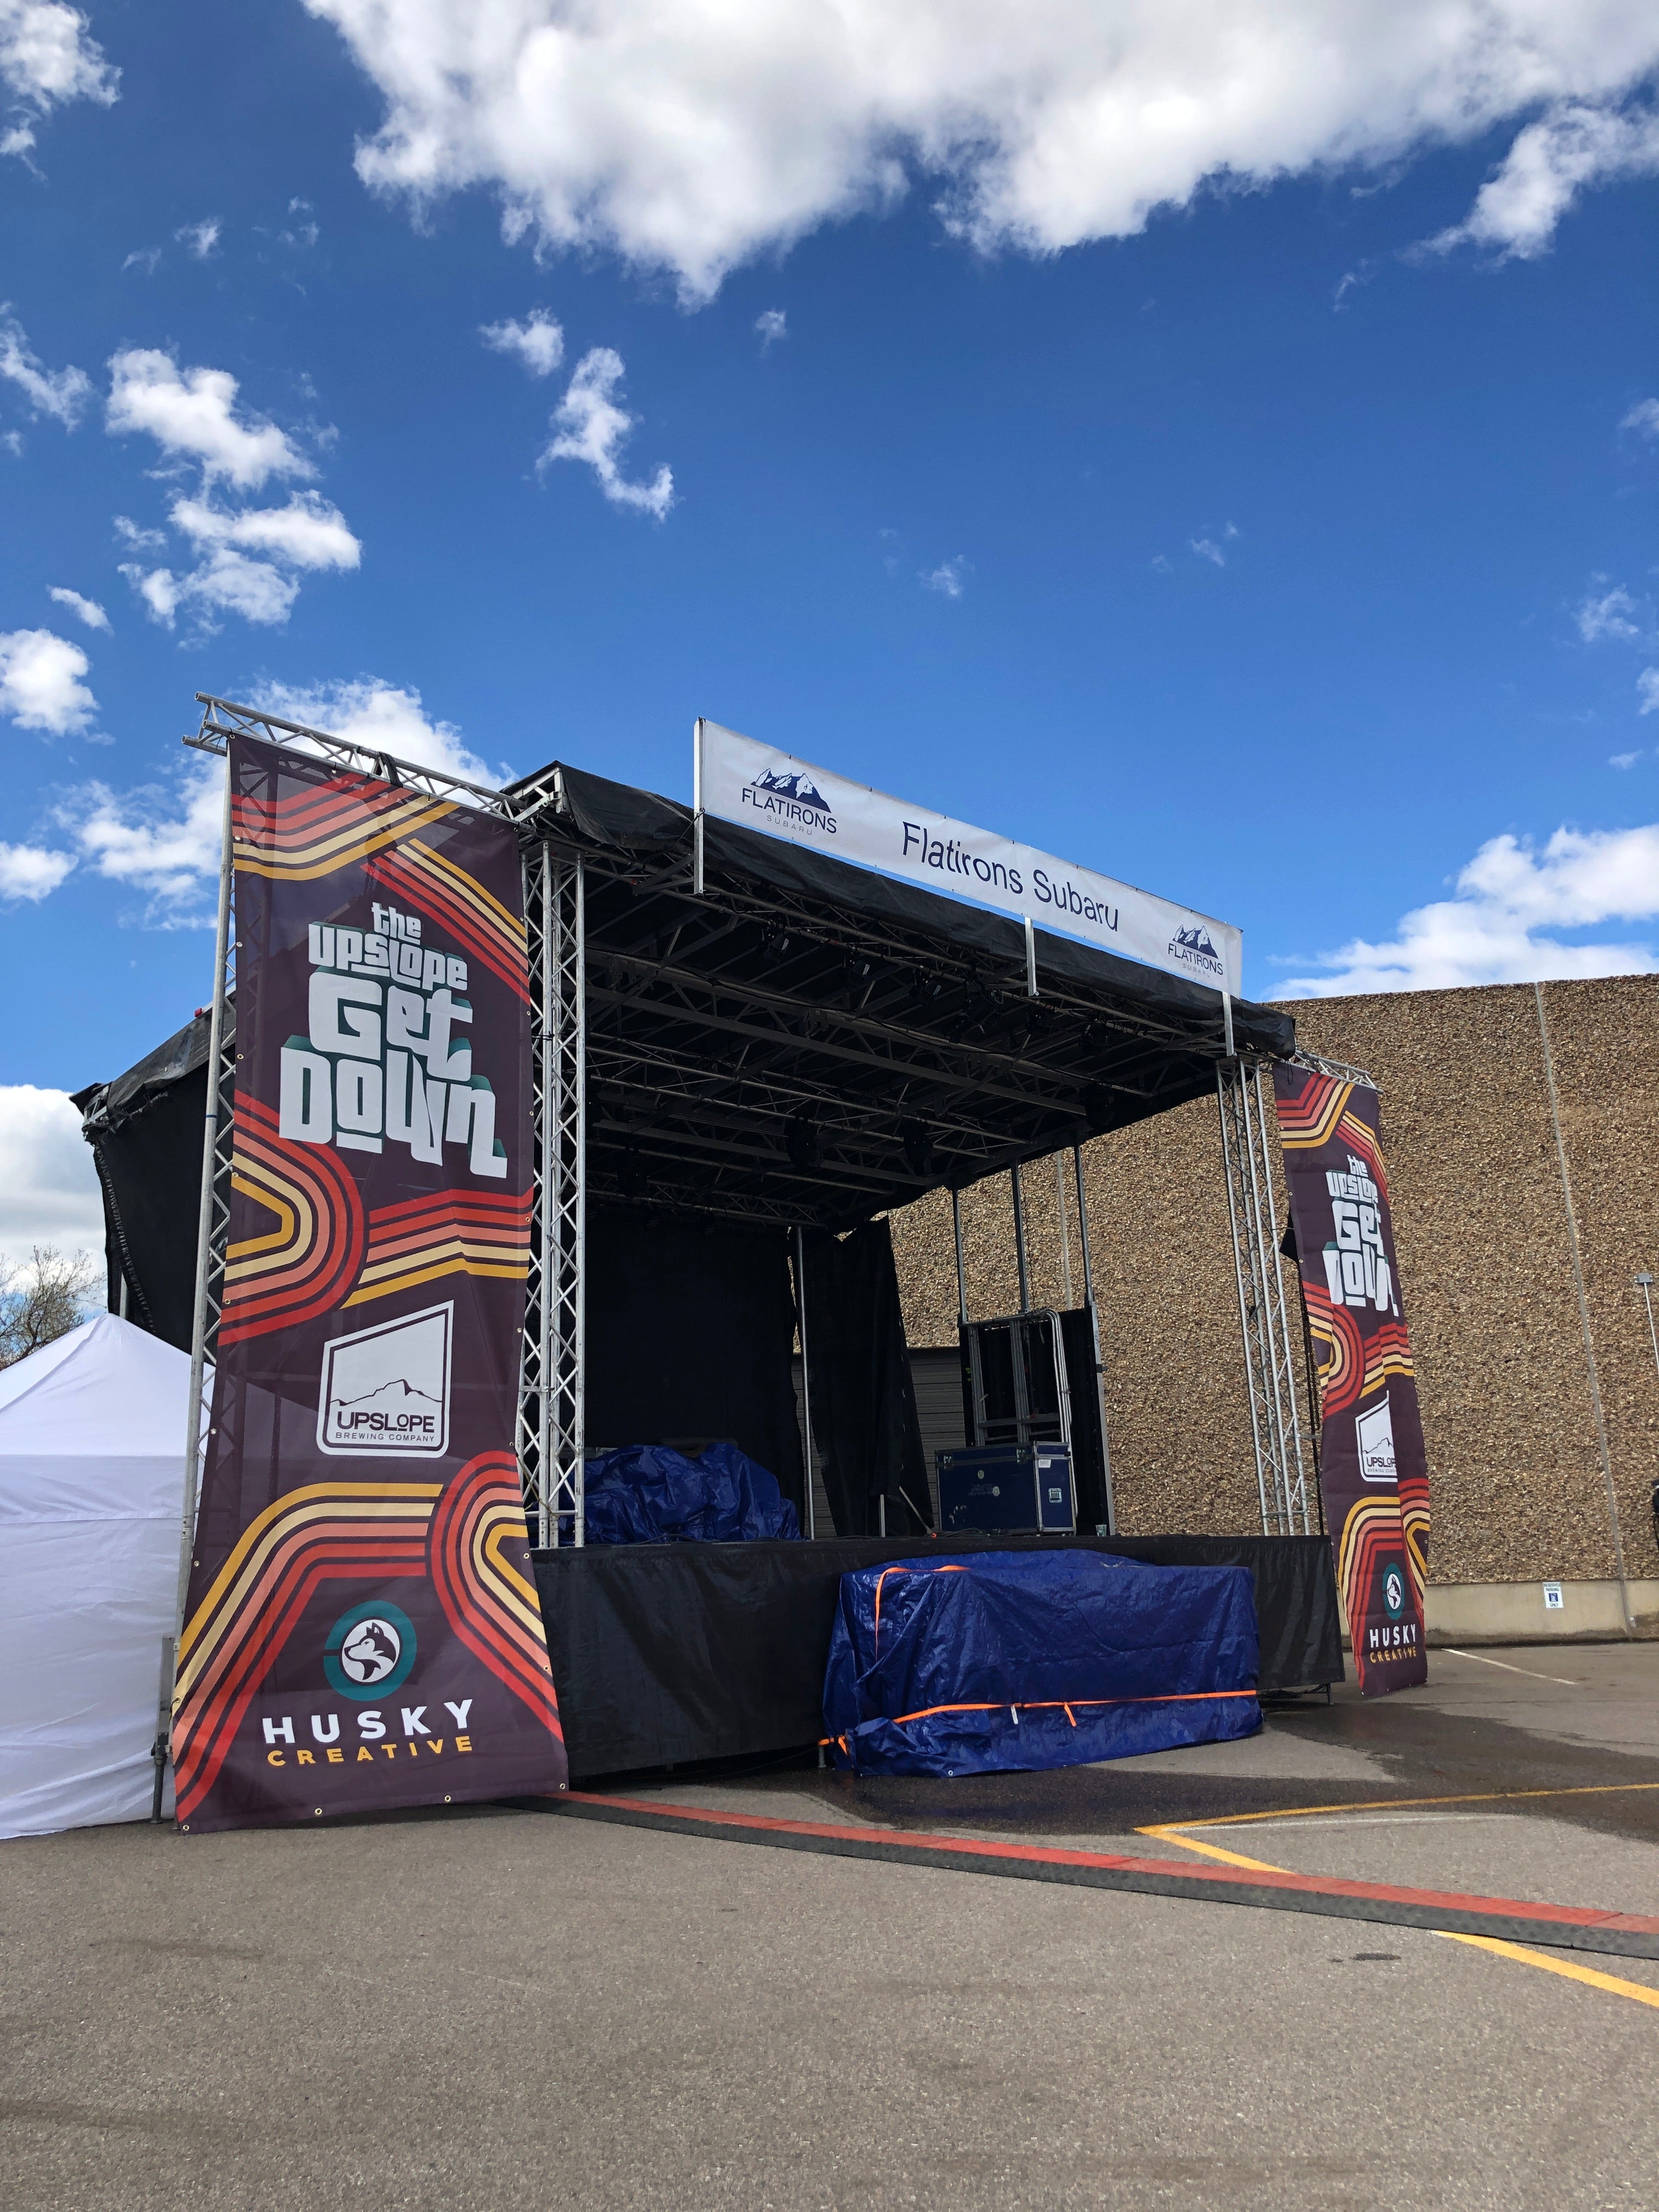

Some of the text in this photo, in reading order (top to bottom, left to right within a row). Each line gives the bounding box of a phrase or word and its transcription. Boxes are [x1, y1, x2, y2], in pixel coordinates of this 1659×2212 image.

[742, 787, 837, 834] FLATIRONS
[766, 815, 812, 836] SUBARU
[902, 821, 1119, 932] Flatirons Subaru
[371, 901, 421, 945] the
[1168, 943, 1223, 975] FLATIRONS
[1182, 963, 1210, 978] SUBARU
[1347, 1154, 1368, 1177] the
[337, 1411, 435, 1432] UPSLOPE
[389, 1434, 435, 1442] COMPANY
[1367, 1457, 1396, 1468] UPSLOP
[1369, 1624, 1416, 1647] HUSKY
[1370, 1646, 1417, 1663] CREATIVE
[262, 1699, 473, 1744] HUSKY
[267, 1735, 473, 1767] CREATIVE
